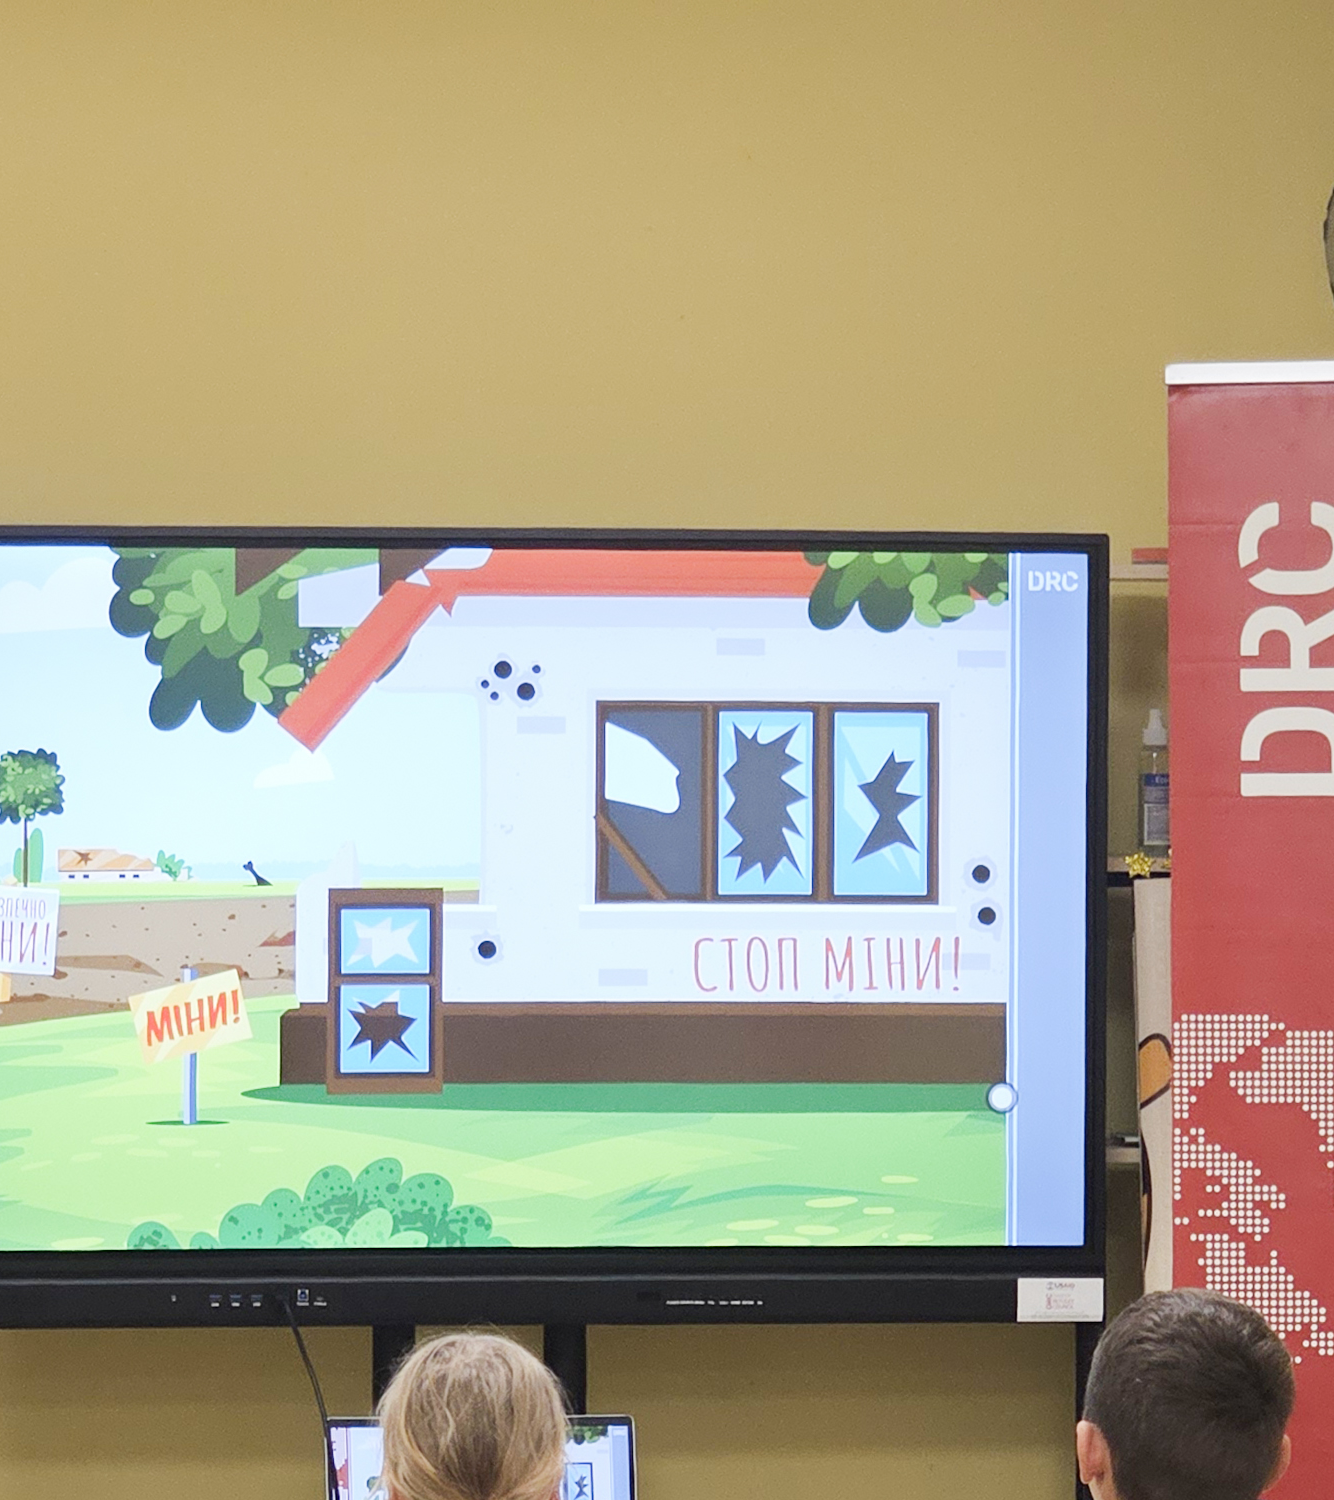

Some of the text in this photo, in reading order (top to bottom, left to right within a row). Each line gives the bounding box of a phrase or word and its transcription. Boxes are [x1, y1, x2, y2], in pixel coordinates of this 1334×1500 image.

[1028, 570, 1079, 592] DRC
[694, 936, 960, 992] СТОП МІНИ!
[146, 989, 241, 1047] МІНИ!
